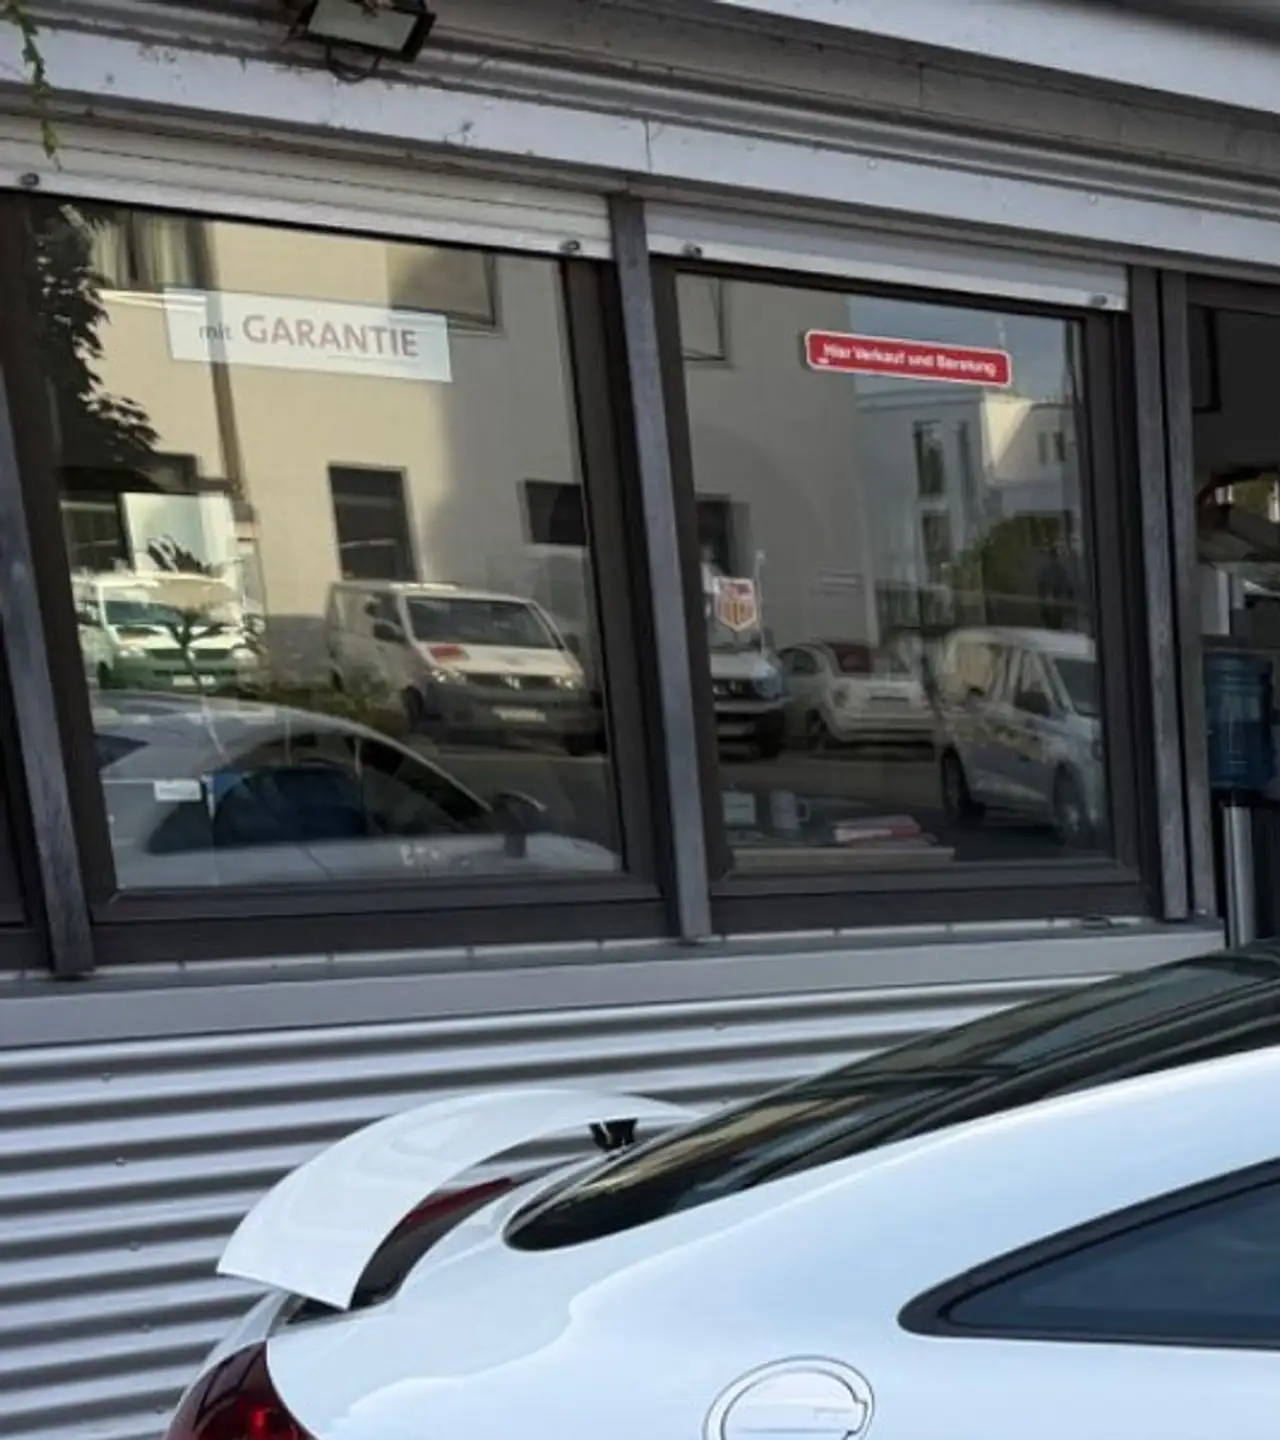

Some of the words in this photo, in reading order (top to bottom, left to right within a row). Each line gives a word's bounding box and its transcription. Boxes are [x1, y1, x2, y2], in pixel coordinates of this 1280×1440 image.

[242, 314, 420, 358] GARANTIE
[852, 346, 905, 364] Verkauf
[908, 353, 935, 367] und
[936, 355, 998, 378] Beratung
